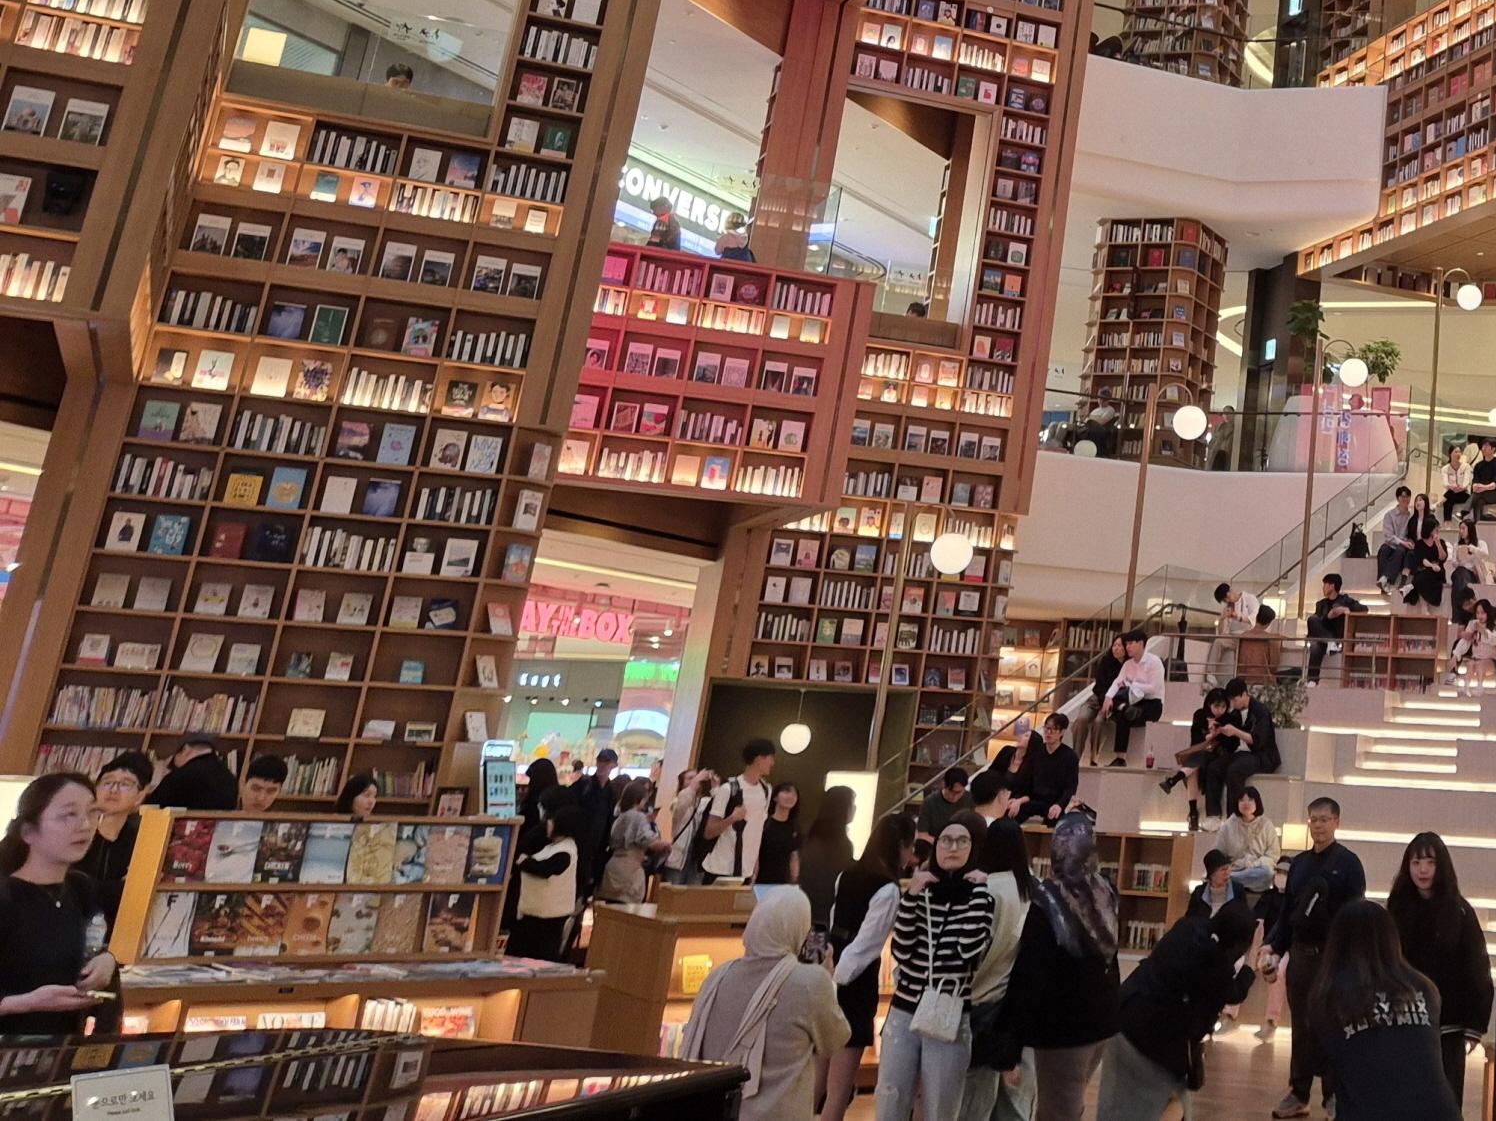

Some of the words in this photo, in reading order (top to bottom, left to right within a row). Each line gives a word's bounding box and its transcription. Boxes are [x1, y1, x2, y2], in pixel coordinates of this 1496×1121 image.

[618, 164, 731, 234] ONVERS
[578, 608, 634, 644] BOX
[166, 894, 178, 908] F
